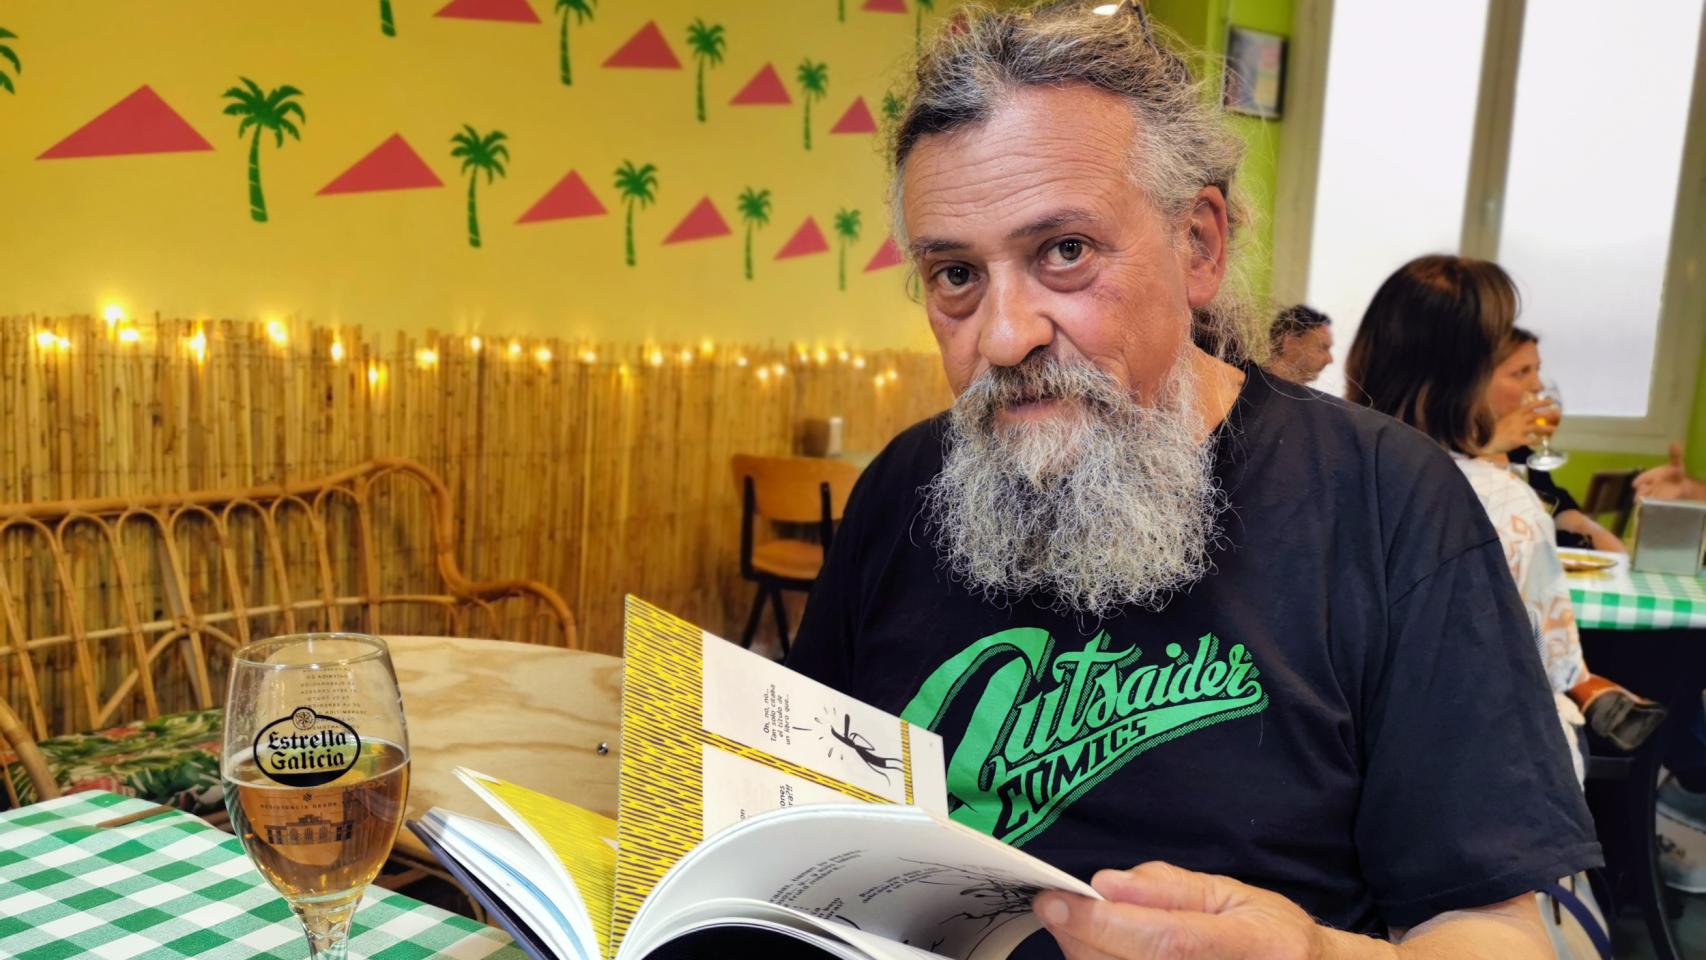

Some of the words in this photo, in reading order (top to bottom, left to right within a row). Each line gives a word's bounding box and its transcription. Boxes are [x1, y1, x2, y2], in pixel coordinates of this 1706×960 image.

[268, 730, 347, 750] Estrella
[777, 730, 784, 738] el
[785, 735, 791, 745] un
[271, 749, 344, 770] Galicia
[992, 715, 1149, 839] COMICS
